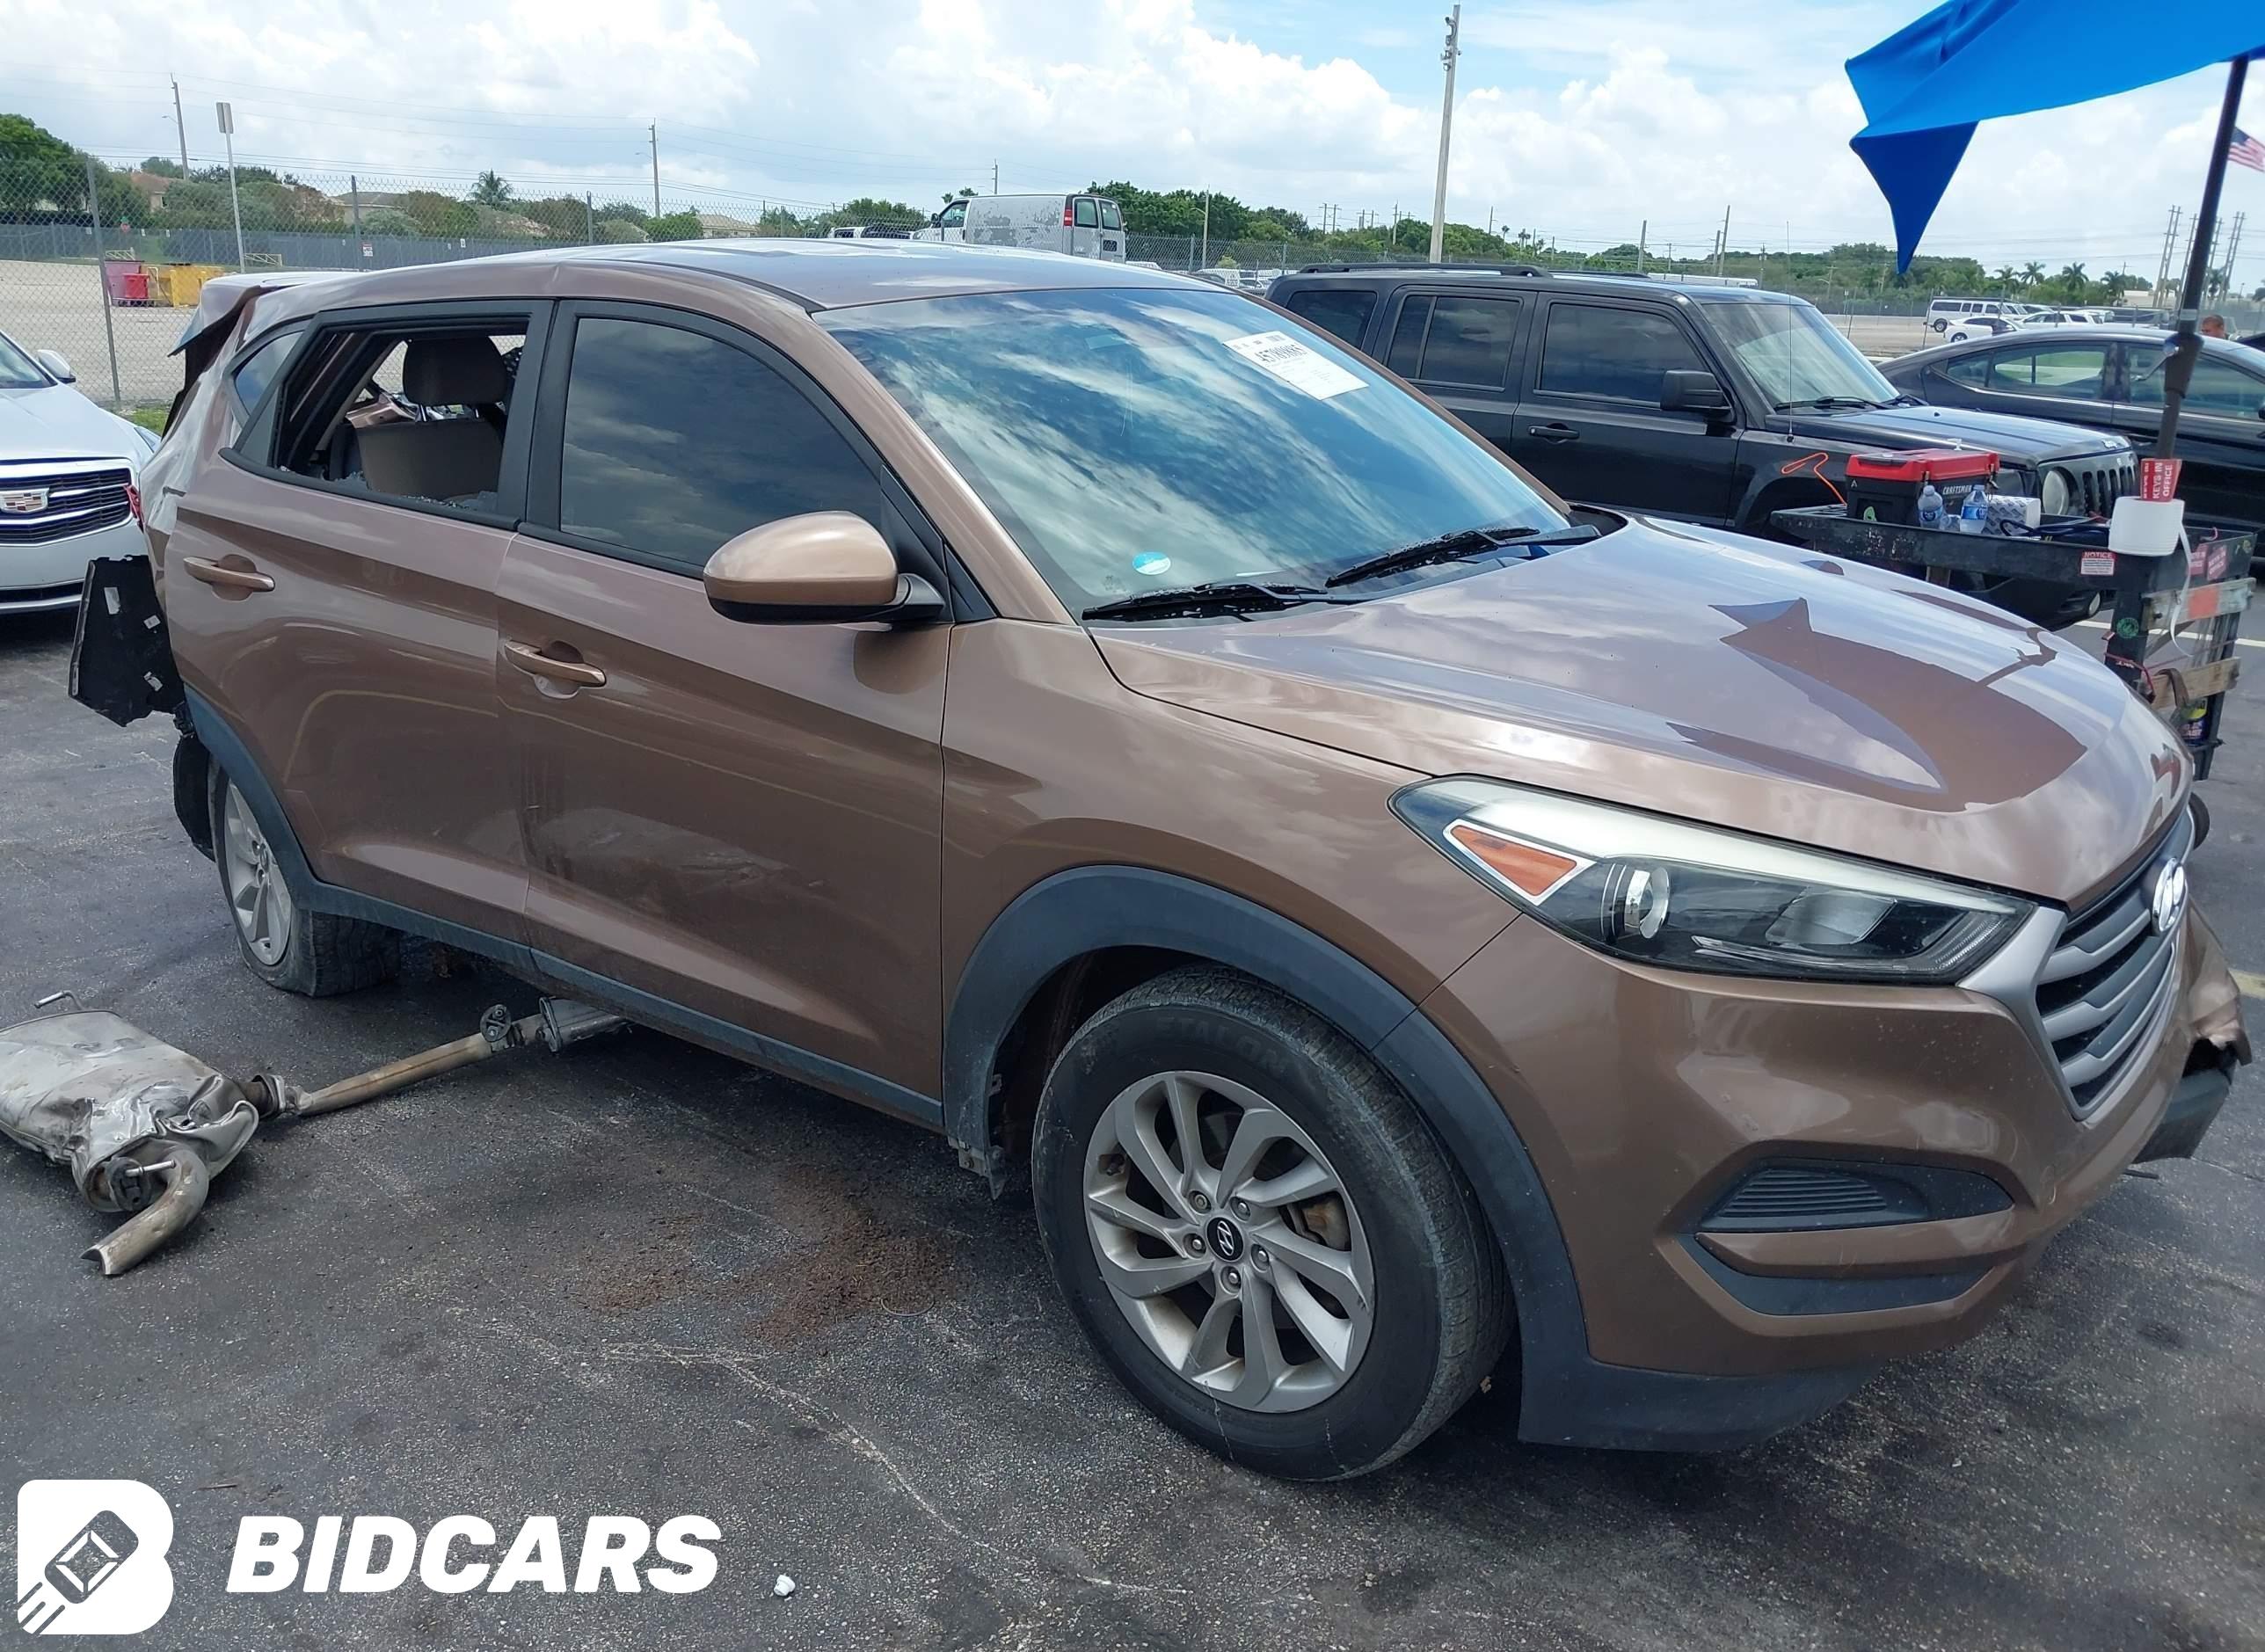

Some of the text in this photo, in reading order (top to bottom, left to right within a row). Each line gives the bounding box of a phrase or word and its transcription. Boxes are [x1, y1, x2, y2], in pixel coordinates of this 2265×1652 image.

[2152, 462, 2163, 499] KEYS IN
[2163, 464, 2174, 497] OFFICE
[1156, 1016, 1289, 1076] ETALON
